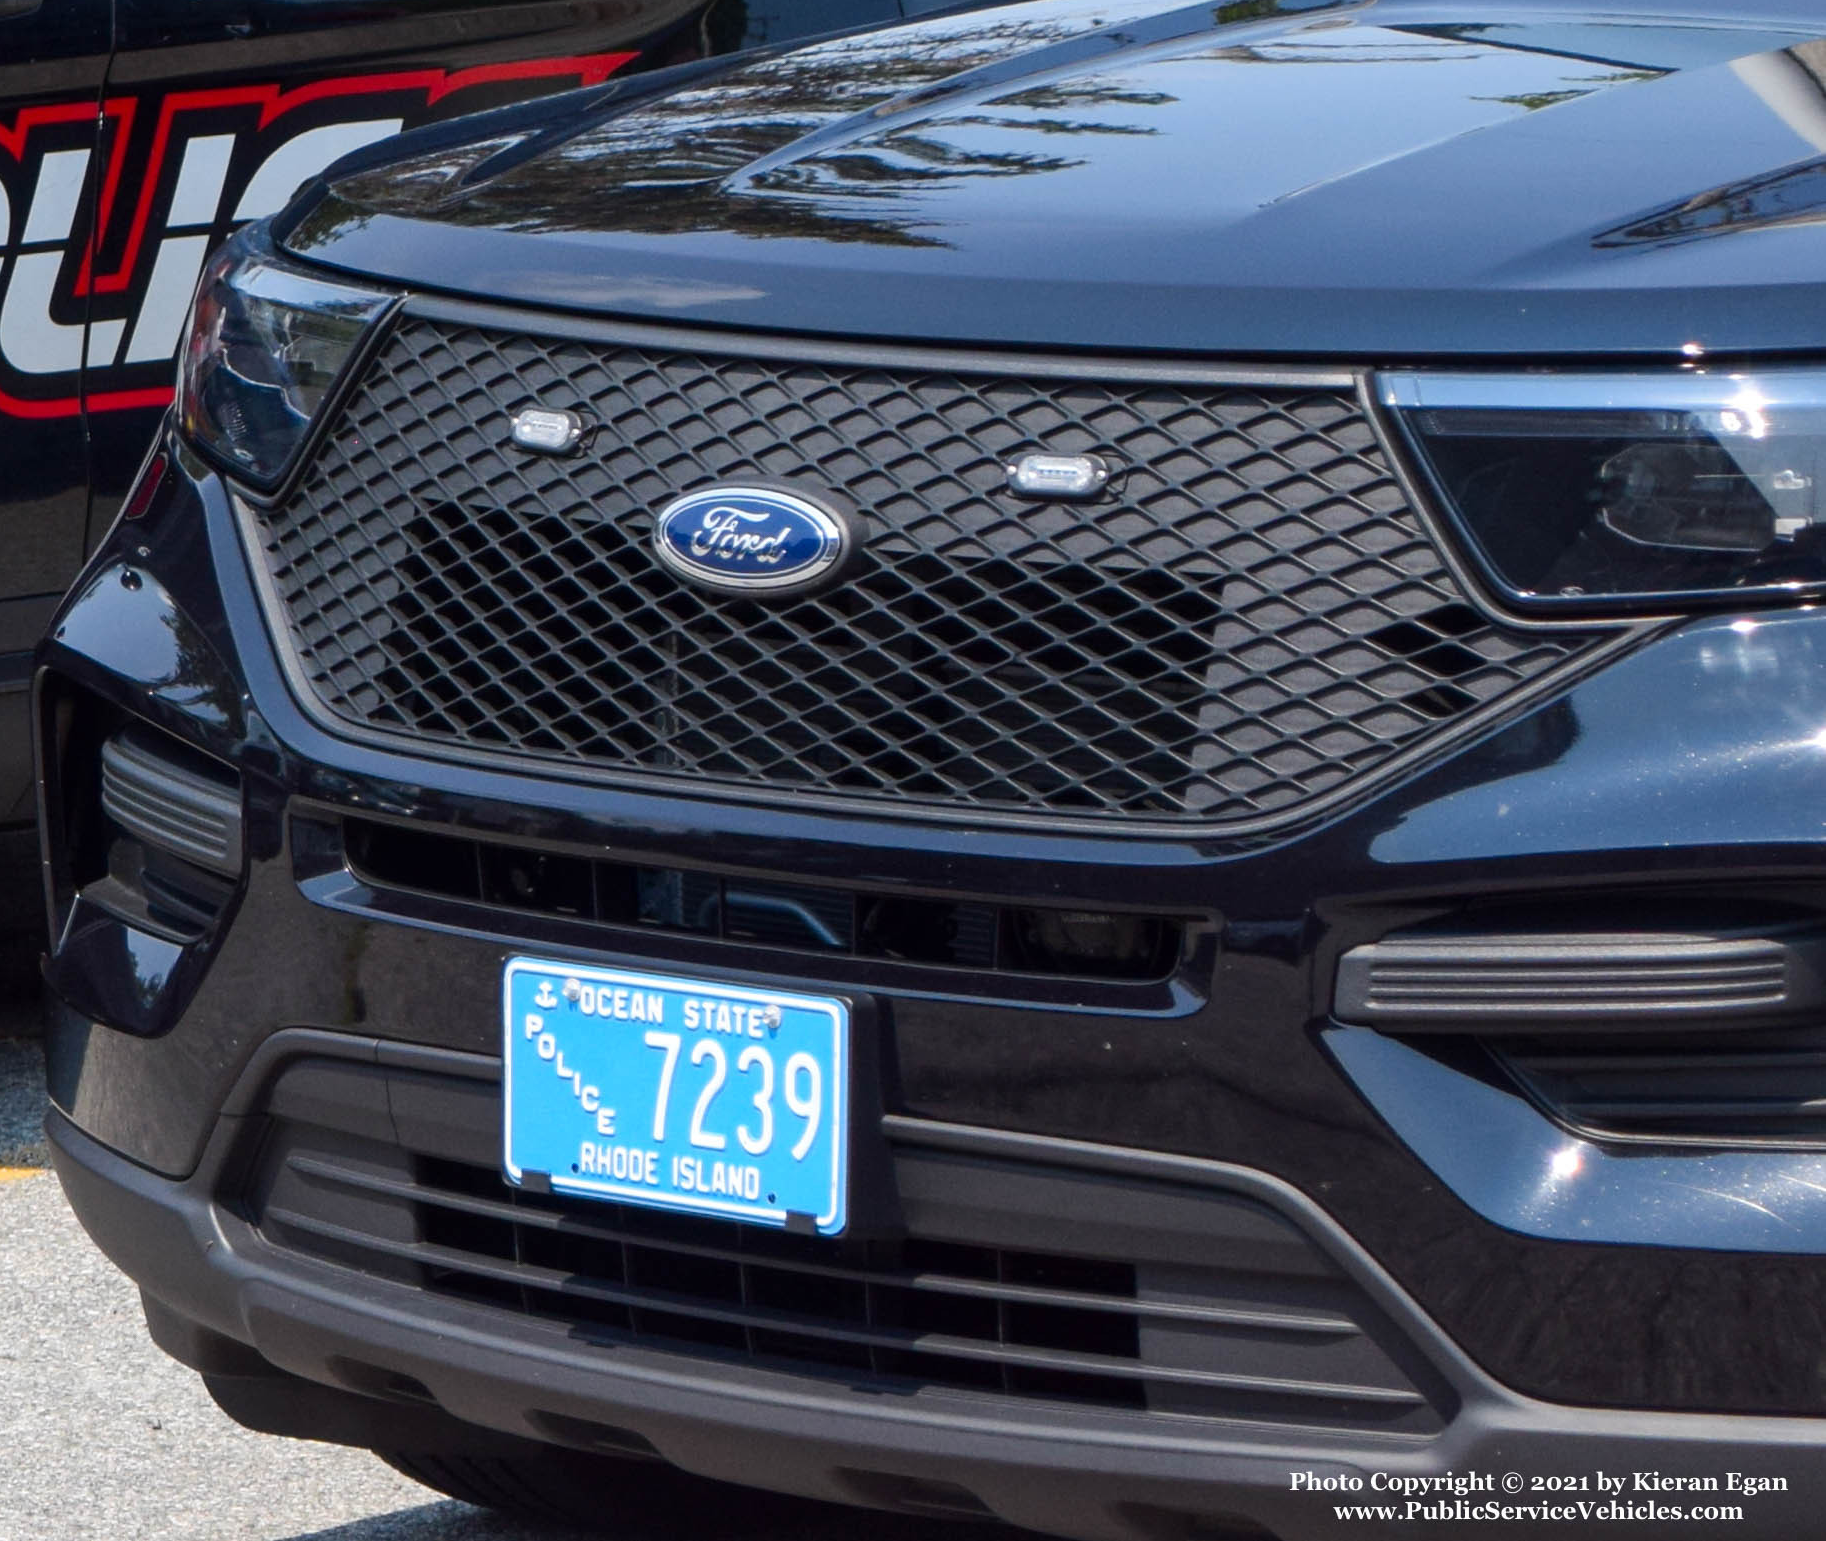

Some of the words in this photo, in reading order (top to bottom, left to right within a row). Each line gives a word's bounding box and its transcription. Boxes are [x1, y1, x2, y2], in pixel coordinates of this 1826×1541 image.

[690, 506, 792, 564] Ford
[578, 985, 664, 1024] OCEAN
[683, 998, 764, 1039] STATE
[525, 1013, 616, 1136] POLICE
[644, 1030, 821, 1161] 7239
[580, 1141, 660, 1186] RHODE
[672, 1156, 760, 1201] ISLAND
